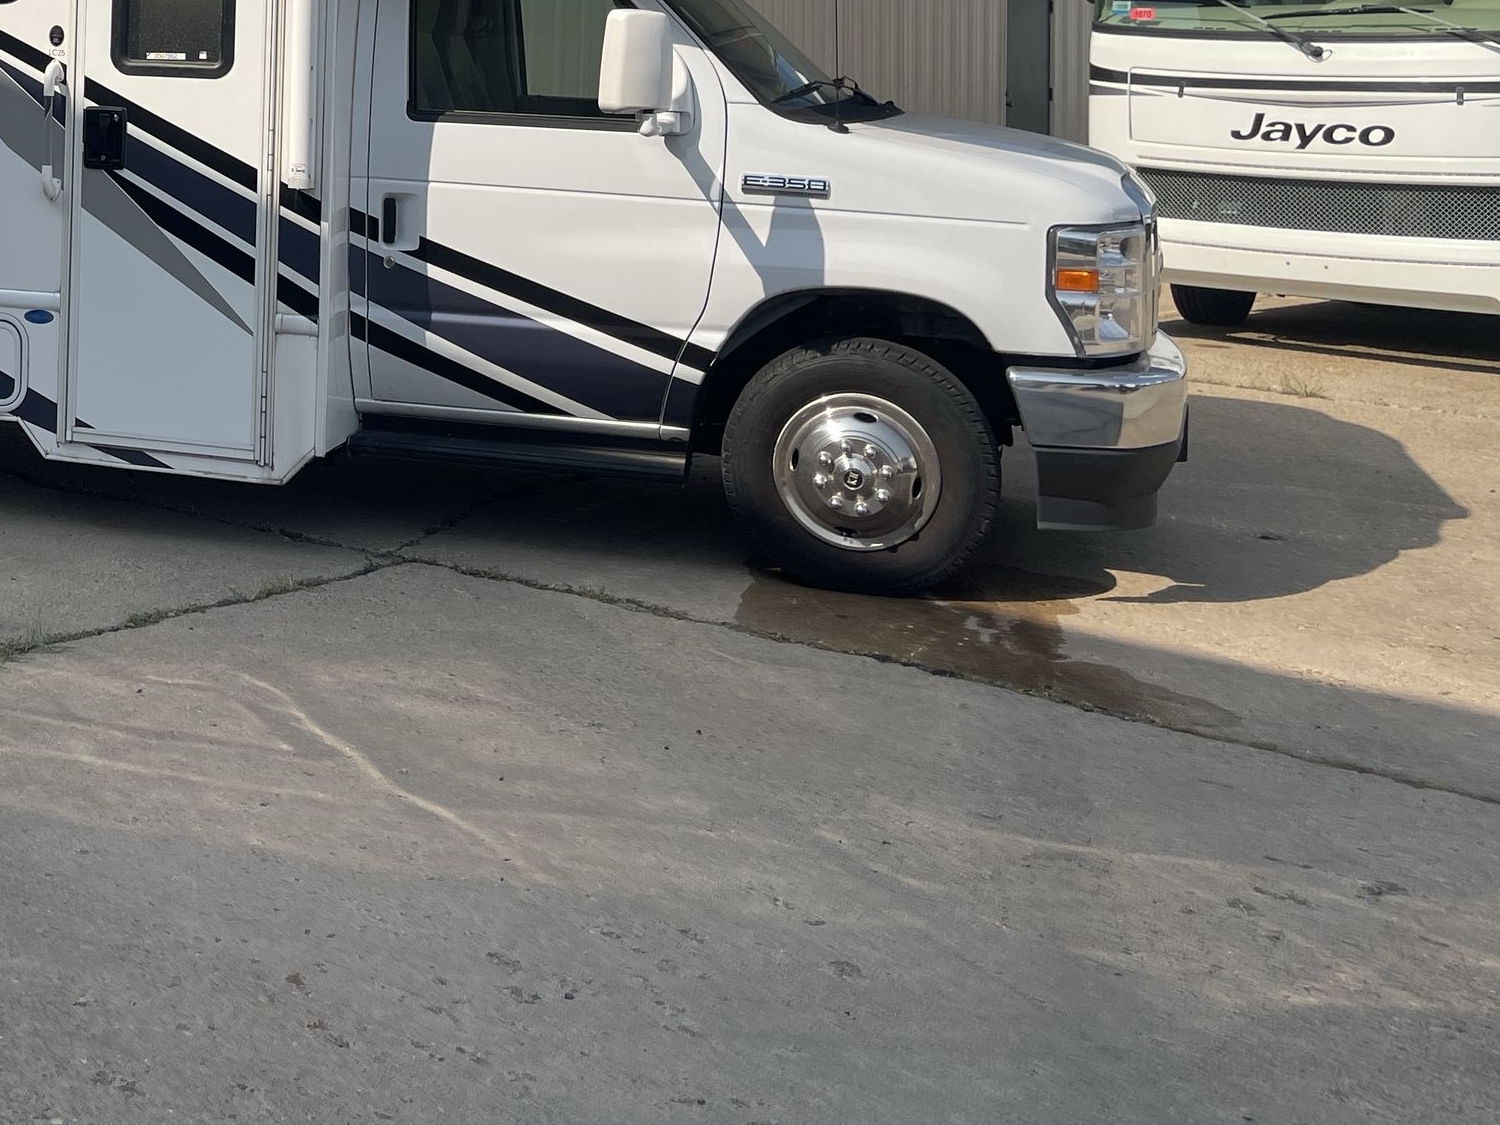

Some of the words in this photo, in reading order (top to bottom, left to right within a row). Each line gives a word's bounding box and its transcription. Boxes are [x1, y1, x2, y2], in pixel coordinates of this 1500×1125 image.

[1134, 9, 1152, 19] 1070
[1230, 113, 1396, 149] Jayco
[743, 175, 827, 191] E-350
